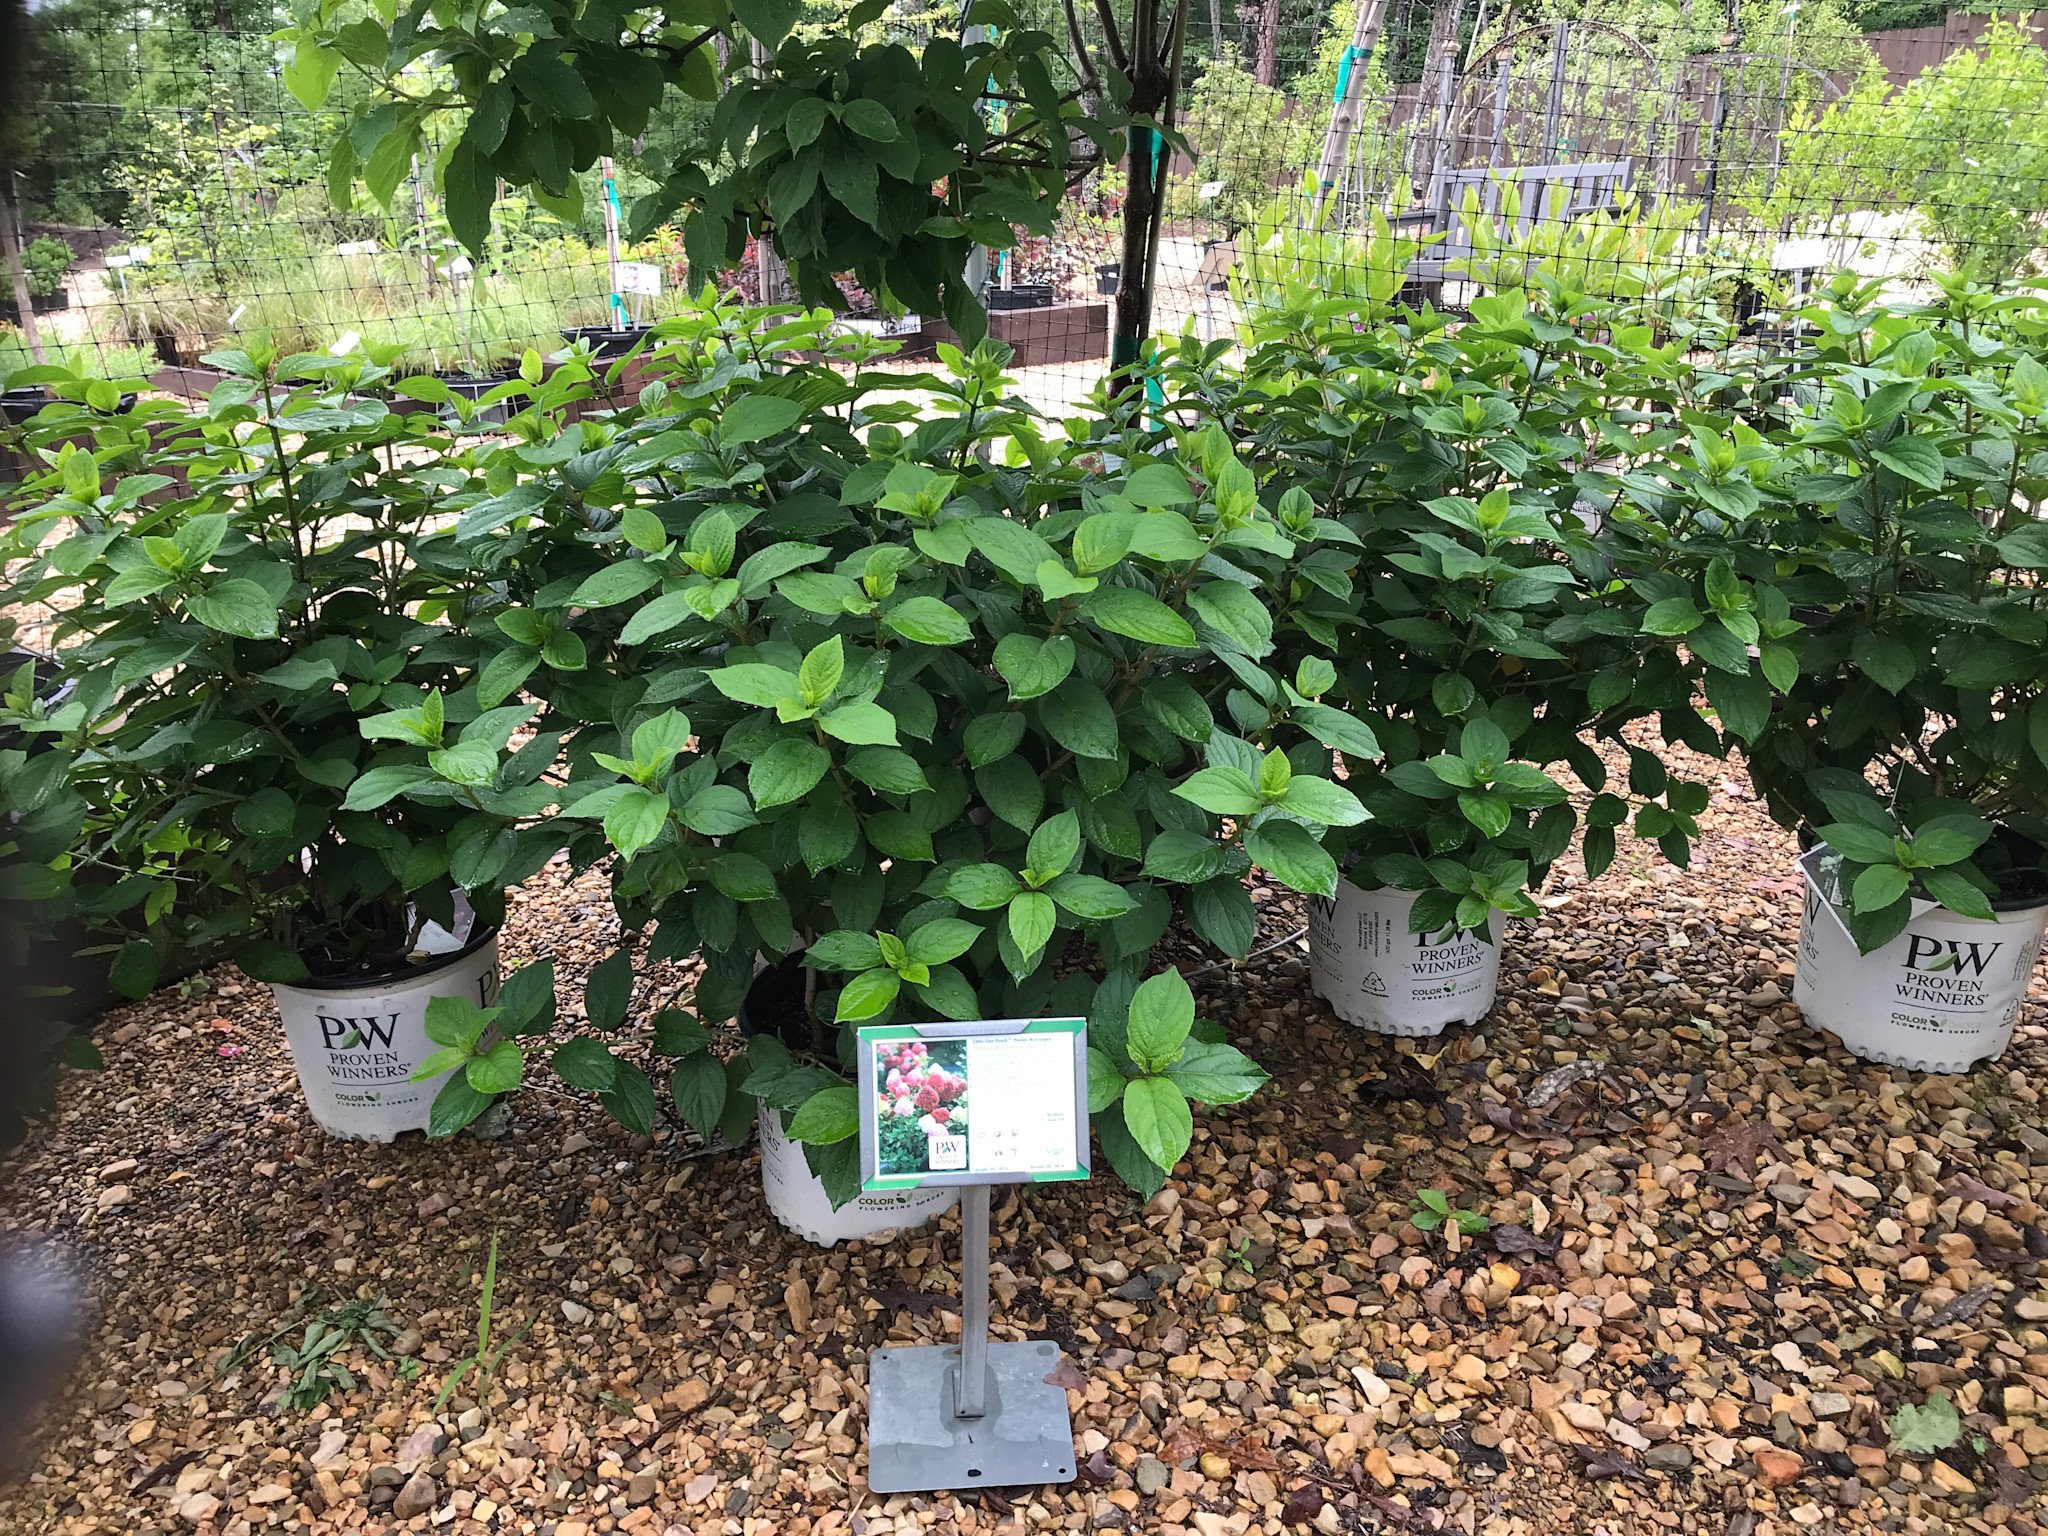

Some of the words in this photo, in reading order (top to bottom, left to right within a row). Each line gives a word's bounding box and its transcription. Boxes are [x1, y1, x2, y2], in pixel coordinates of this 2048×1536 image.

[1419, 940, 1479, 962] PROVEN
[1901, 932, 2003, 977] PW
[1370, 978, 1378, 986] 2
[1904, 971, 1984, 992] PROVEN
[1412, 988, 1441, 996] COLOR
[1412, 993, 1455, 1001] FLOWERING
[1891, 1012, 1928, 1025] COLOR
[315, 1012, 401, 1051] PW
[1890, 1020, 1944, 1033] FLOWERING
[329, 1051, 399, 1066] PROVEN
[335, 1093, 364, 1103] COLOR
[386, 1097, 419, 1107] SHRUBS
[935, 1140, 960, 1154] PW
[858, 1197, 895, 1206] COLOR
[917, 1191, 945, 1206] SHRUBS
